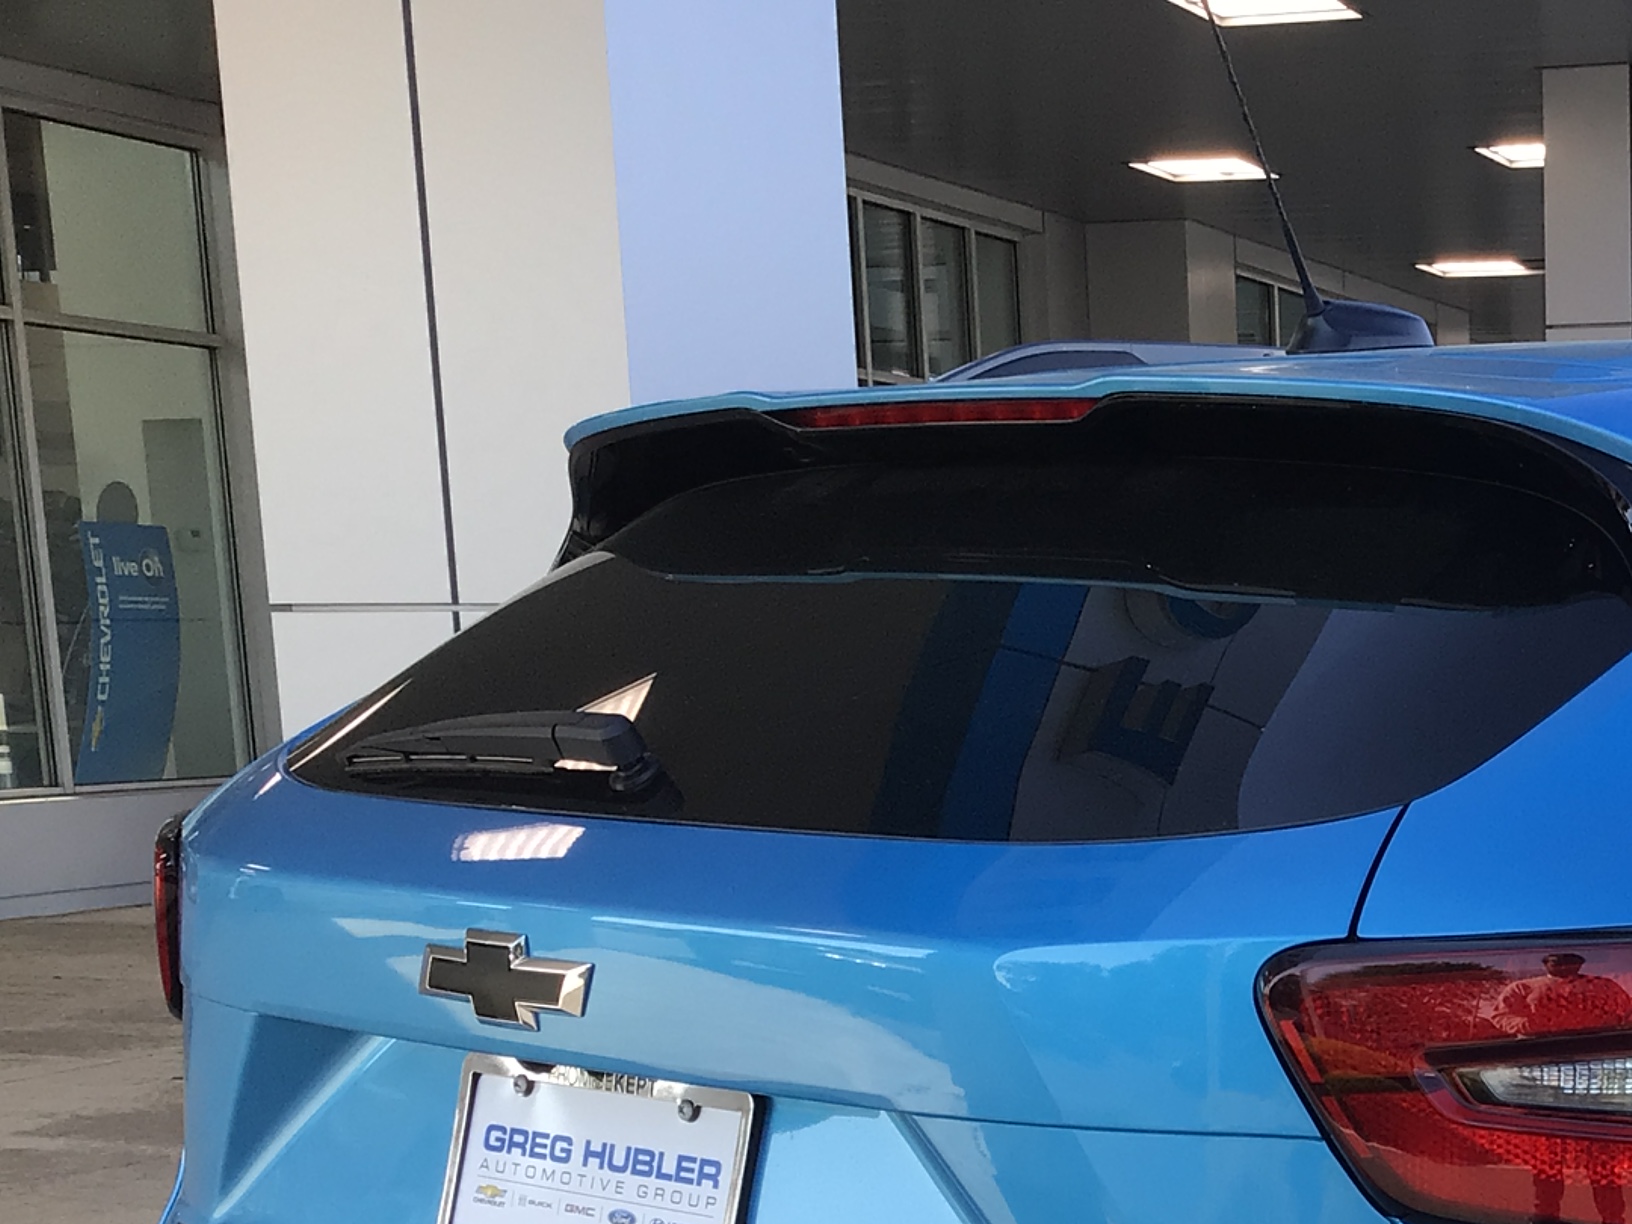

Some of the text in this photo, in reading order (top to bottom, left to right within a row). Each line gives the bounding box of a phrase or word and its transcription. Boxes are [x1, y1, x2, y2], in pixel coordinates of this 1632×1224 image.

[112, 556, 139, 576] live
[87, 530, 112, 701] CHEVROLET
[483, 1123, 722, 1190] GREG HUBLER
[479, 1158, 717, 1209] AUTOMOTIVE GROUP
[564, 1203, 595, 1217] GMC
